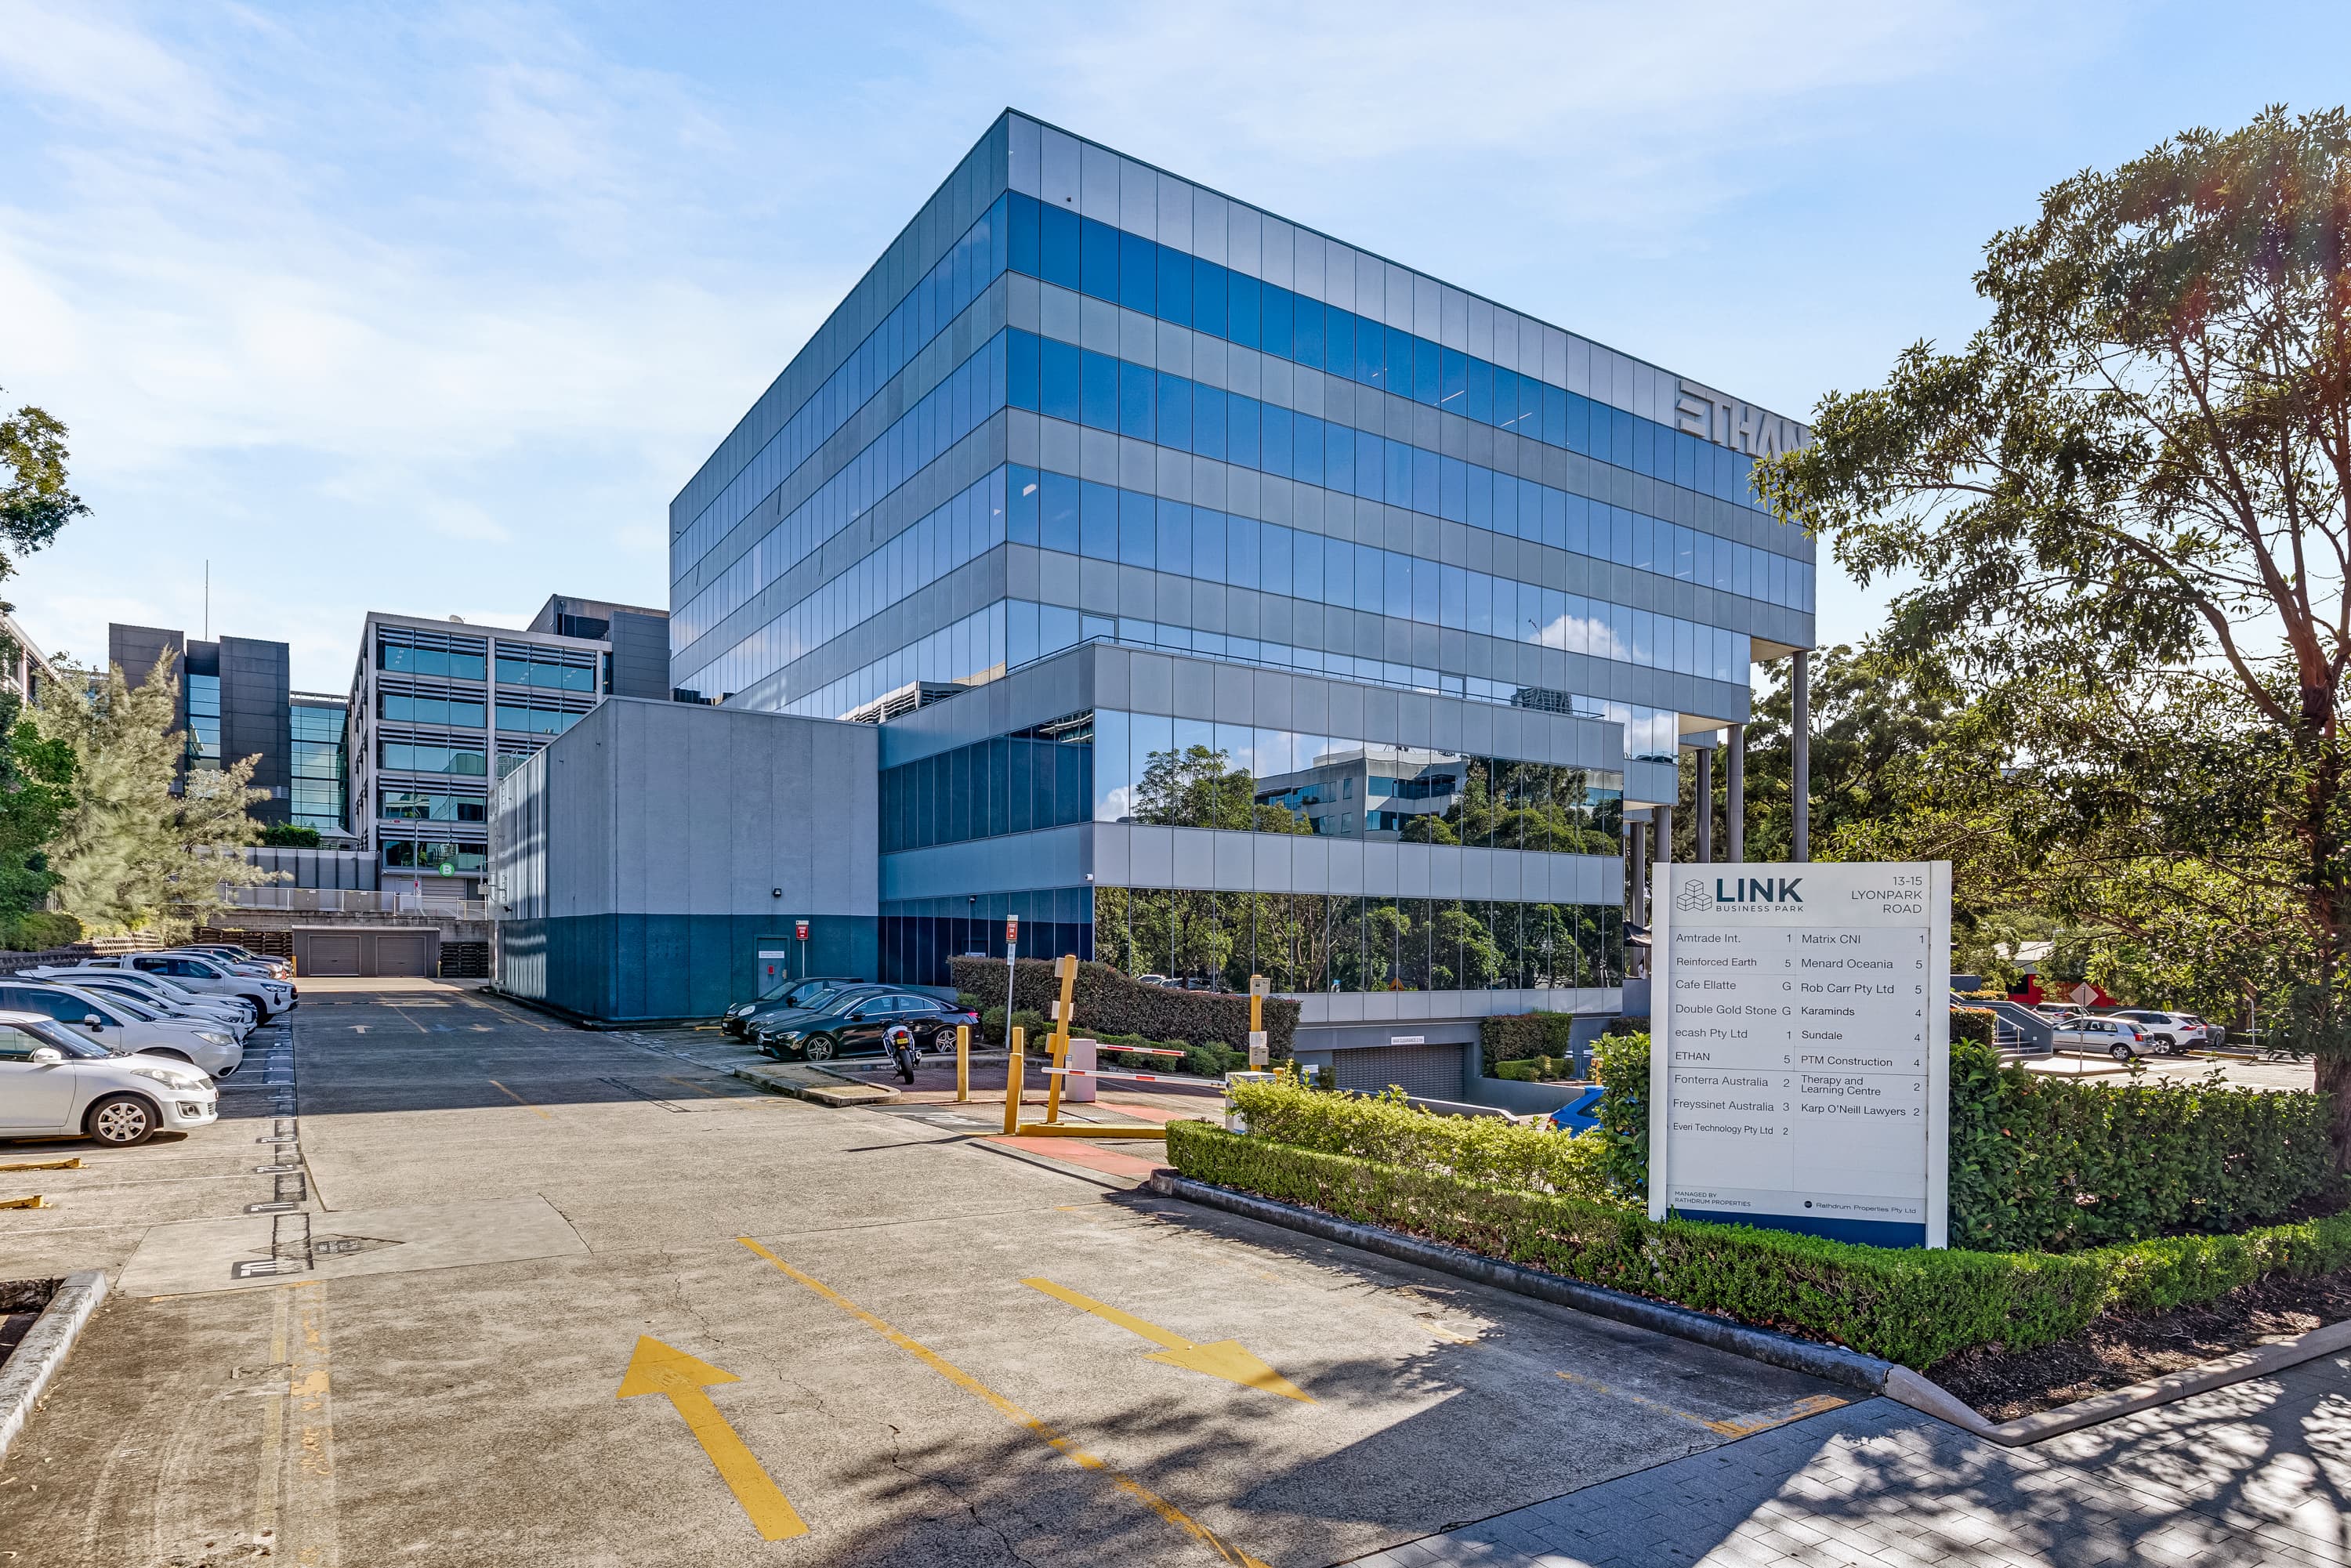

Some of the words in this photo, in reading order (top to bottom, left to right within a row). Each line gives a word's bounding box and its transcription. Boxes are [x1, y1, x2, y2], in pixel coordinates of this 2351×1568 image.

[1893, 876, 1922, 886] 13-15
[1715, 878, 1803, 903] LINK
[1851, 889, 1922, 900] LYONPARK
[1882, 904, 1922, 914] ROAD
[1675, 933, 1722, 943] Amtrade
[1724, 933, 1741, 943] Int.
[1786, 933, 1791, 943] 1
[1802, 934, 1836, 944] Matrix
[1839, 934, 1860, 944] CNI
[1918, 934, 1924, 944] 1
[1676, 957, 1729, 966] Reinforced
[1731, 958, 1757, 966] Earth
[1784, 959, 1791, 968] 5
[1801, 958, 1843, 969] Menard
[1846, 958, 1893, 969] Oceania
[1915, 959, 1923, 969] 5
[1675, 980, 1701, 990] Cafe
[1704, 980, 1737, 990] Ellatte
[1782, 981, 1791, 991] G
[1801, 983, 1824, 993] Rob
[1827, 983, 1852, 993] Carr
[1854, 983, 1873, 996] Pty
[1876, 983, 1894, 994] Ltd
[1914, 985, 1922, 994] 5
[1675, 1004, 1713, 1014] Double
[1716, 1005, 1742, 1015] Gold
[1744, 1005, 1777, 1016] Stone
[1781, 1006, 1791, 1016] G
[1801, 1006, 1855, 1016] Karaminds
[1914, 1009, 1922, 1018] 4
[1675, 1028, 1707, 1037] ecash
[1710, 1028, 1727, 1040] Pty
[1730, 1029, 1748, 1038] Ltd
[1786, 1030, 1791, 1040] 1
[1801, 1030, 1843, 1041] Sundale
[1914, 1034, 1921, 1042] 4
[1675, 1051, 1710, 1061] ETHAN
[1784, 1055, 1791, 1064] 5
[1801, 1055, 1824, 1065] PTM
[1827, 1056, 1893, 1066] Construction
[1913, 1059, 1920, 1067] 4
[1674, 1074, 1719, 1085] Fonterra
[1721, 1076, 1769, 1087] Australia
[1783, 1078, 1790, 1088] 2
[1800, 1074, 1842, 1087] Therapy
[1844, 1077, 1864, 1085] and
[1801, 1085, 1844, 1097] Learning
[1846, 1085, 1882, 1096] Centre
[1913, 1082, 1921, 1092] 2
[1673, 1098, 1726, 1110] Freyssinet
[1728, 1100, 1775, 1112] Australia
[1782, 1102, 1790, 1112] 3
[1801, 1103, 1825, 1115] Karp
[1828, 1104, 1860, 1114] O'Neill
[1864, 1106, 1907, 1117] Lawyers
[1913, 1107, 1920, 1117] 2
[1673, 1122, 1693, 1131] Everi
[1694, 1123, 1742, 1135] Technology
[1744, 1125, 1758, 1135] Pty
[1759, 1126, 1773, 1135] Ltd
[1783, 1127, 1788, 1135] 2
